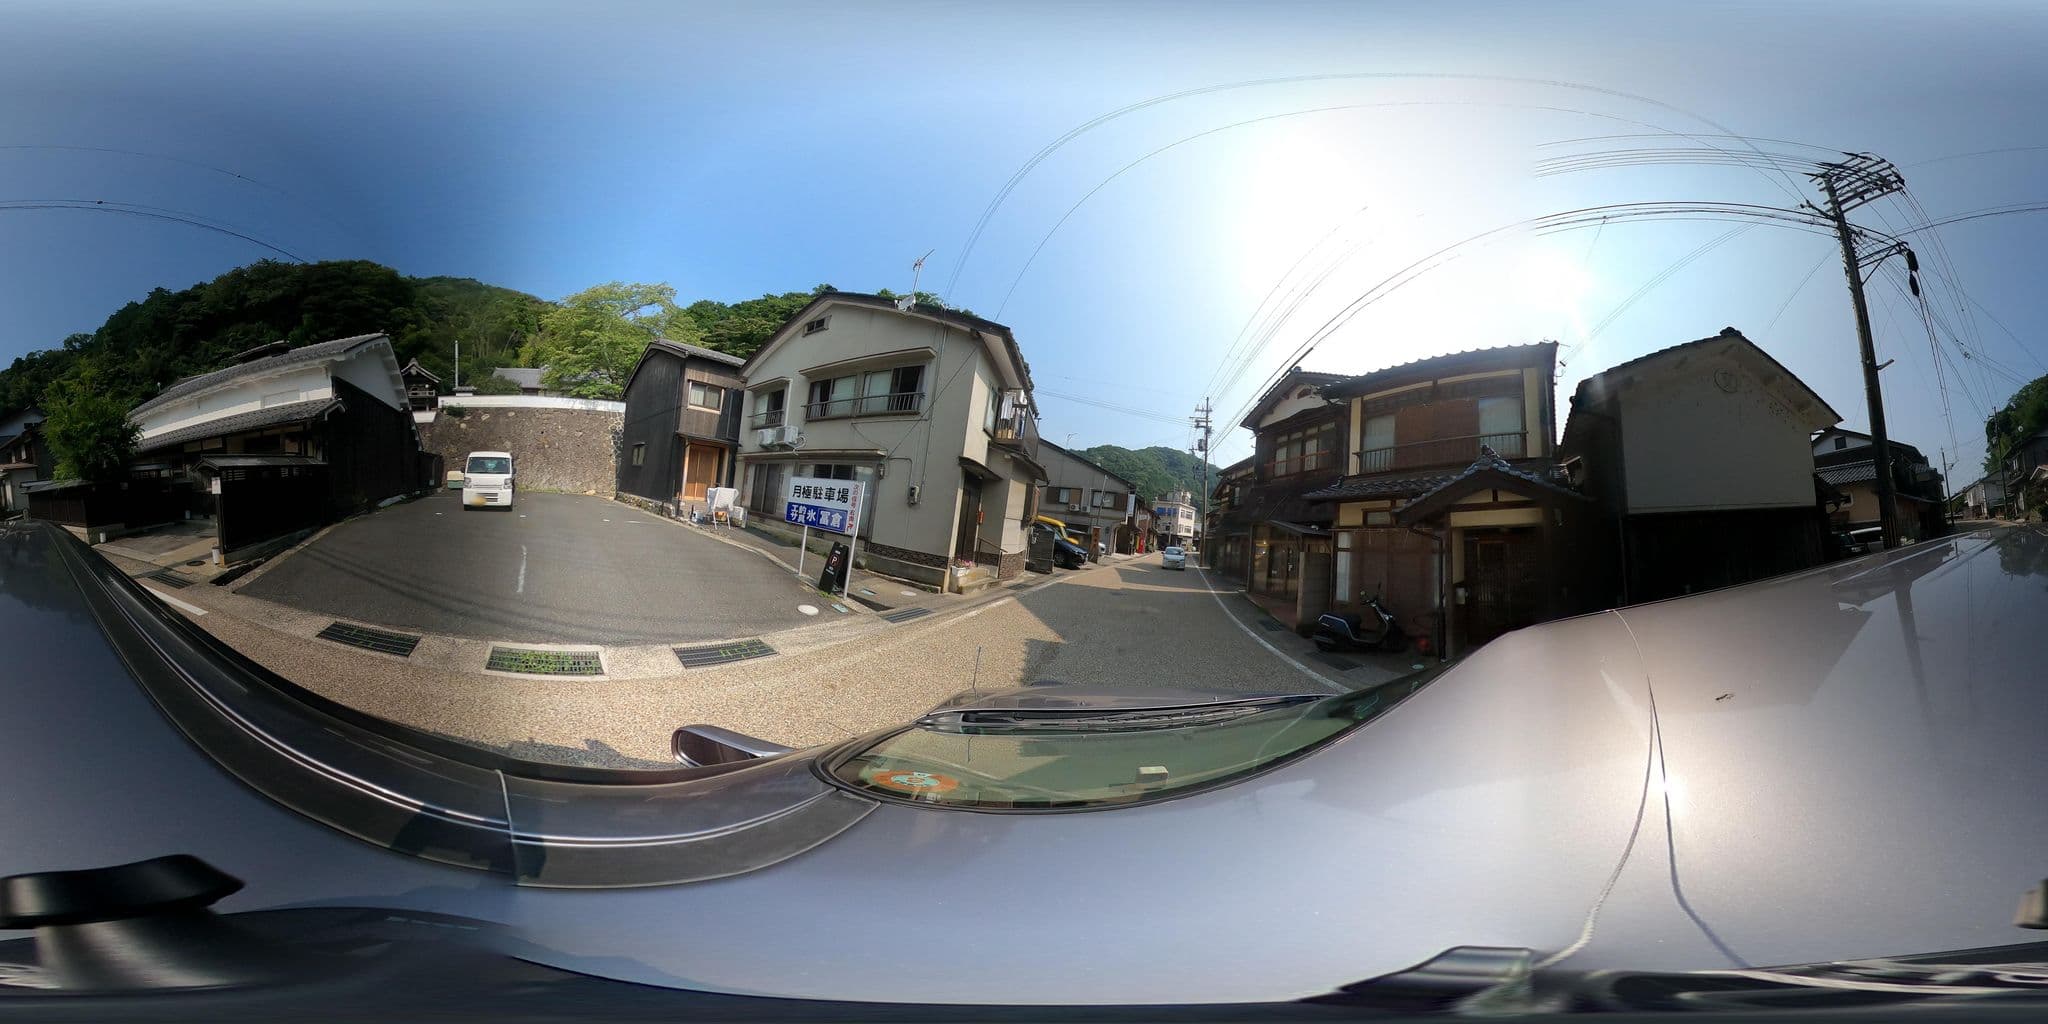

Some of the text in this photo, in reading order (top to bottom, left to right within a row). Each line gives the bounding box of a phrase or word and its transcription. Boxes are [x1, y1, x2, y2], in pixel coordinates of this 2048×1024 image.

[792, 485, 849, 503] 月極駐車場
